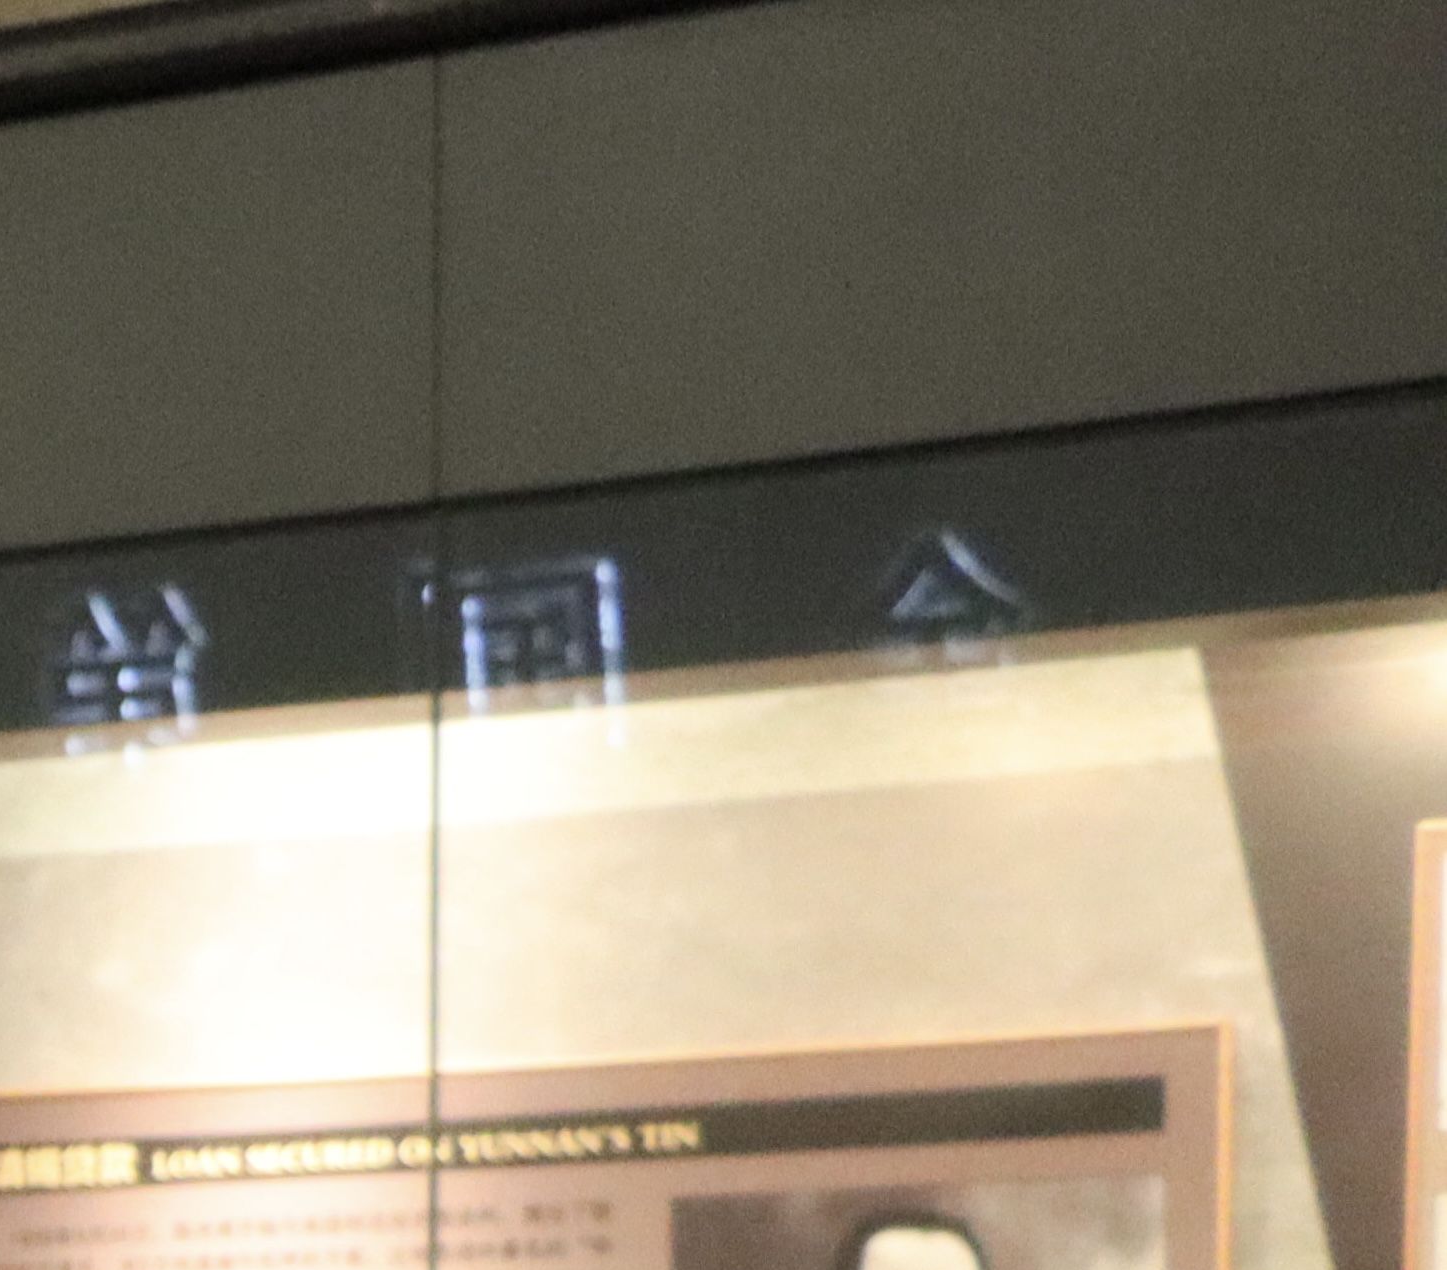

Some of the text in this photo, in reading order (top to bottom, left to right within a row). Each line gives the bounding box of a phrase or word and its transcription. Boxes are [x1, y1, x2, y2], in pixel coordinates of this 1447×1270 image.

[151, 1144, 242, 1182] LOAN
[244, 1135, 397, 1177] SECURED
[458, 1122, 632, 1164] YUNNAN'S
[635, 1119, 700, 1152] TIN
